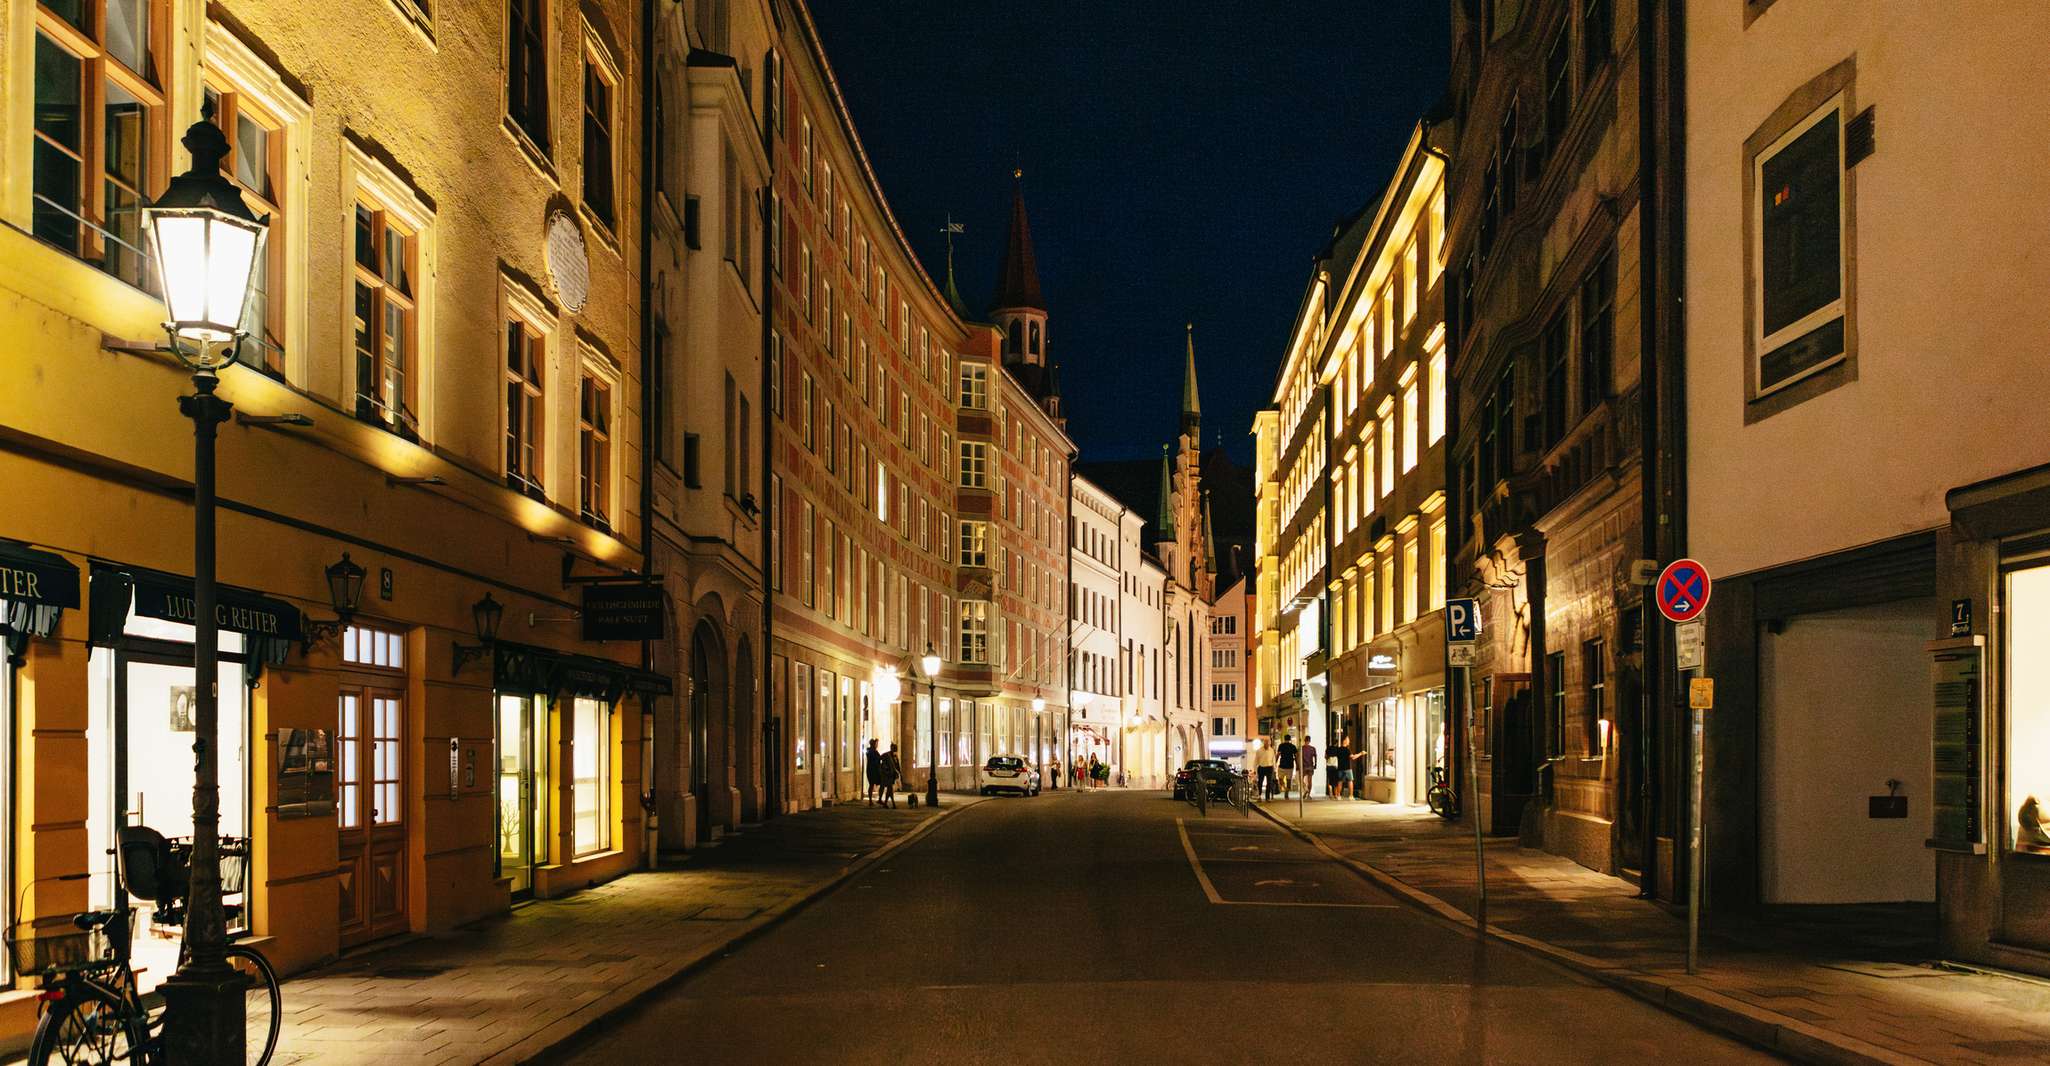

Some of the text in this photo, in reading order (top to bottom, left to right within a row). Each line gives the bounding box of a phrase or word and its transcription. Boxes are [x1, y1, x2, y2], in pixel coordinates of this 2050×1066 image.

[383, 570, 391, 589] 8
[166, 594, 279, 634] LUDG REITER
[1450, 604, 1466, 637] P
[1956, 603, 1964, 620] 7
[1294, 681, 1301, 697] P
